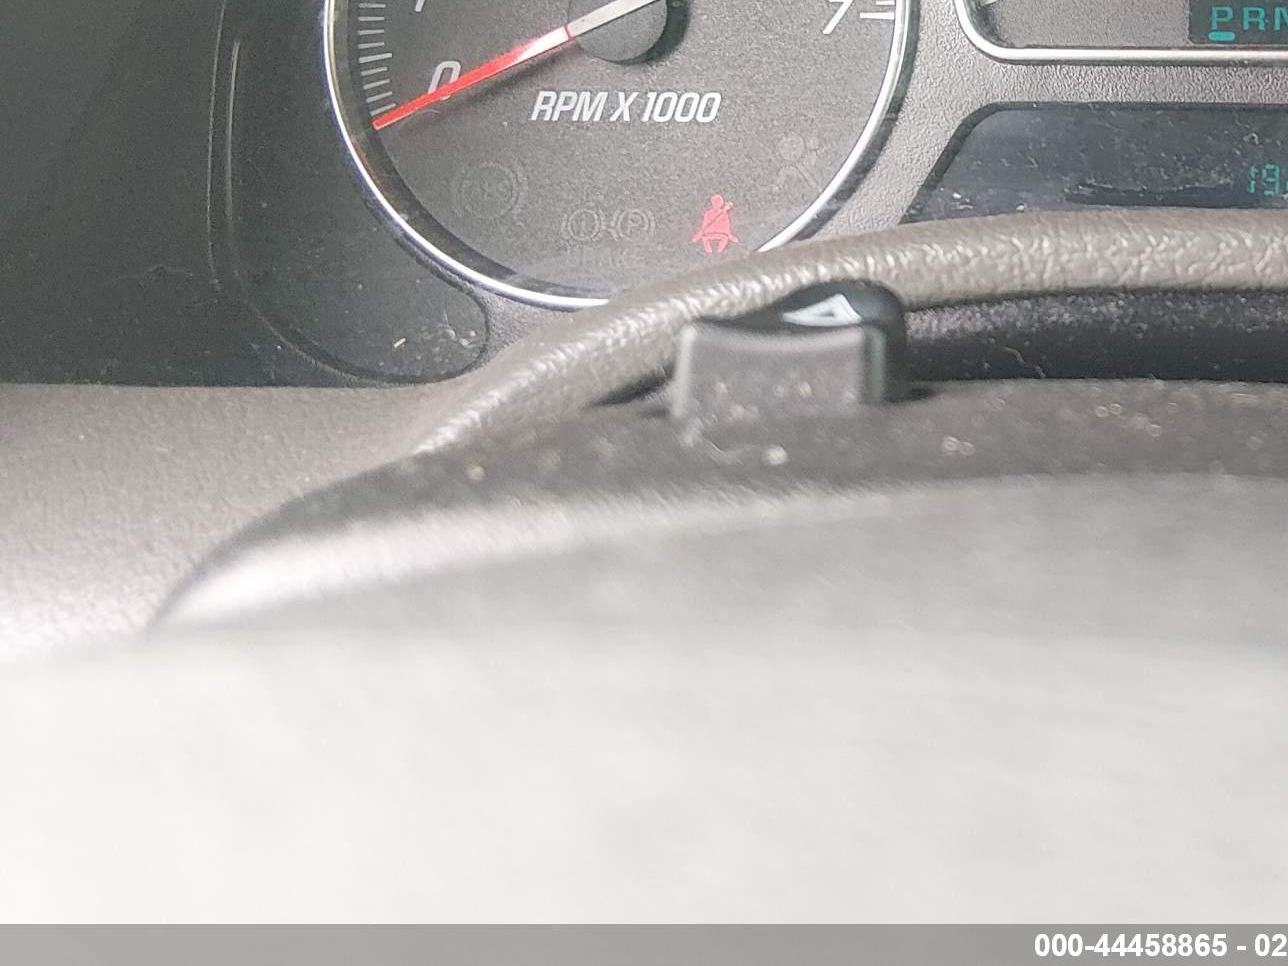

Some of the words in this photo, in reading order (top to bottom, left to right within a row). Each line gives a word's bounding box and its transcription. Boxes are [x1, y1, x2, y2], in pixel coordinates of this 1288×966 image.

[529, 91, 605, 122] RPM
[609, 91, 639, 122] X
[642, 92, 721, 122] 1000
